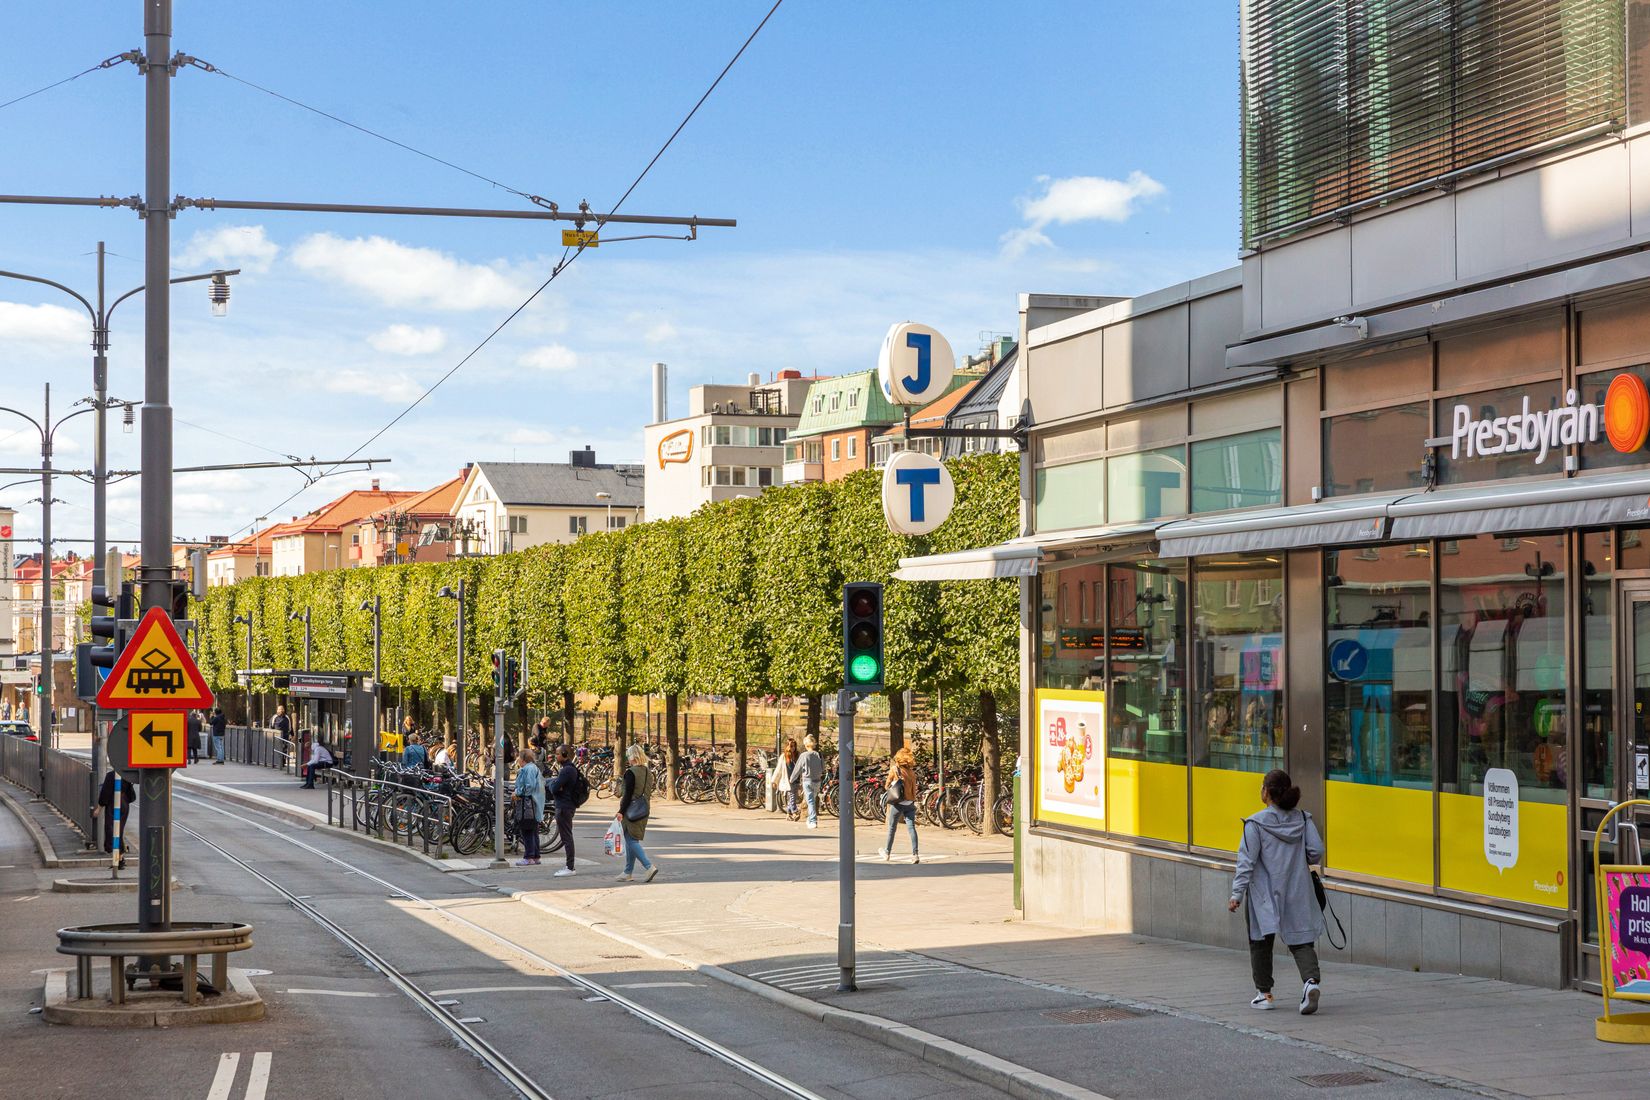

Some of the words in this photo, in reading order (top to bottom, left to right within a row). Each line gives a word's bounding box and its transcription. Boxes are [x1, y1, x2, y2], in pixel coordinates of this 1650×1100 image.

[902, 332, 931, 395] J
[1452, 388, 1599, 465] Pressbyrån
[896, 468, 941, 523] T
